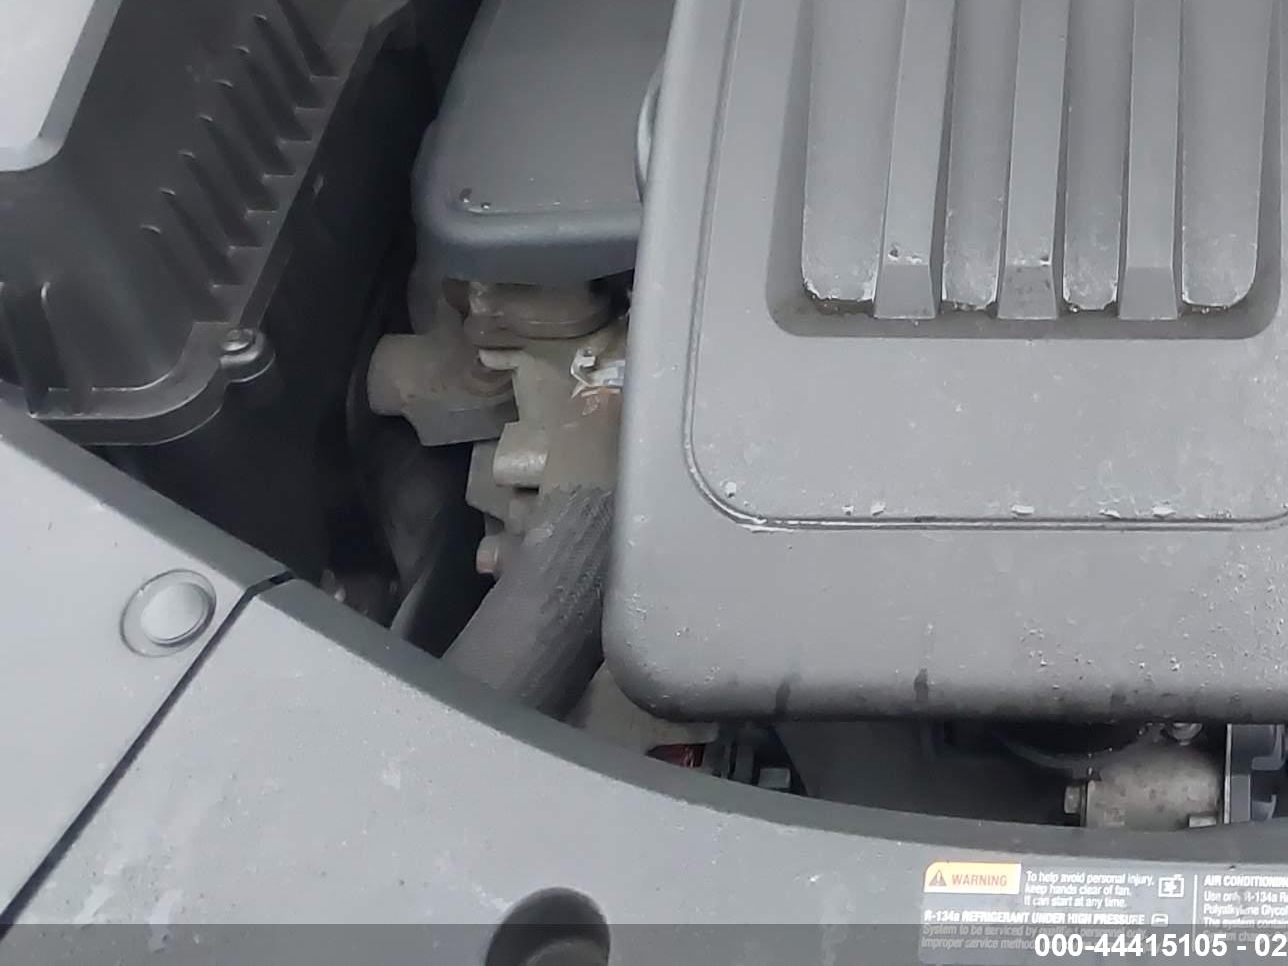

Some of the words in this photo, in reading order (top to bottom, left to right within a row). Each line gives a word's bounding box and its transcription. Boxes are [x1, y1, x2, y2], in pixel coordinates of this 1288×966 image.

[952, 874, 1008, 886] WARNING
[1026, 871, 1037, 882] To
[1039, 871, 1059, 884] help
[1060, 872, 1085, 883] avoid
[1087, 873, 1125, 885] personal
[1204, 875, 1221, 886] AIR
[1024, 883, 1048, 895] keep
[1049, 883, 1077, 895] hands
[1079, 884, 1101, 895] clear
[1103, 885, 1114, 896] of
[1204, 891, 1221, 901] Use
[1032, 897, 1050, 906] can
[1051, 896, 1072, 907] start
[1074, 897, 1084, 907] at
[1085, 898, 1102, 909] any
[923, 909, 960, 922] R-134a
[962, 910, 1030, 923] REFRIGERANT
[1032, 912, 1065, 924] UNDER
[1067, 913, 1092, 924] HIGH
[1093, 913, 1145, 924] PRESSURE
[1261, 905, 1288, 917] Glycol
[1203, 917, 1221, 927] The
